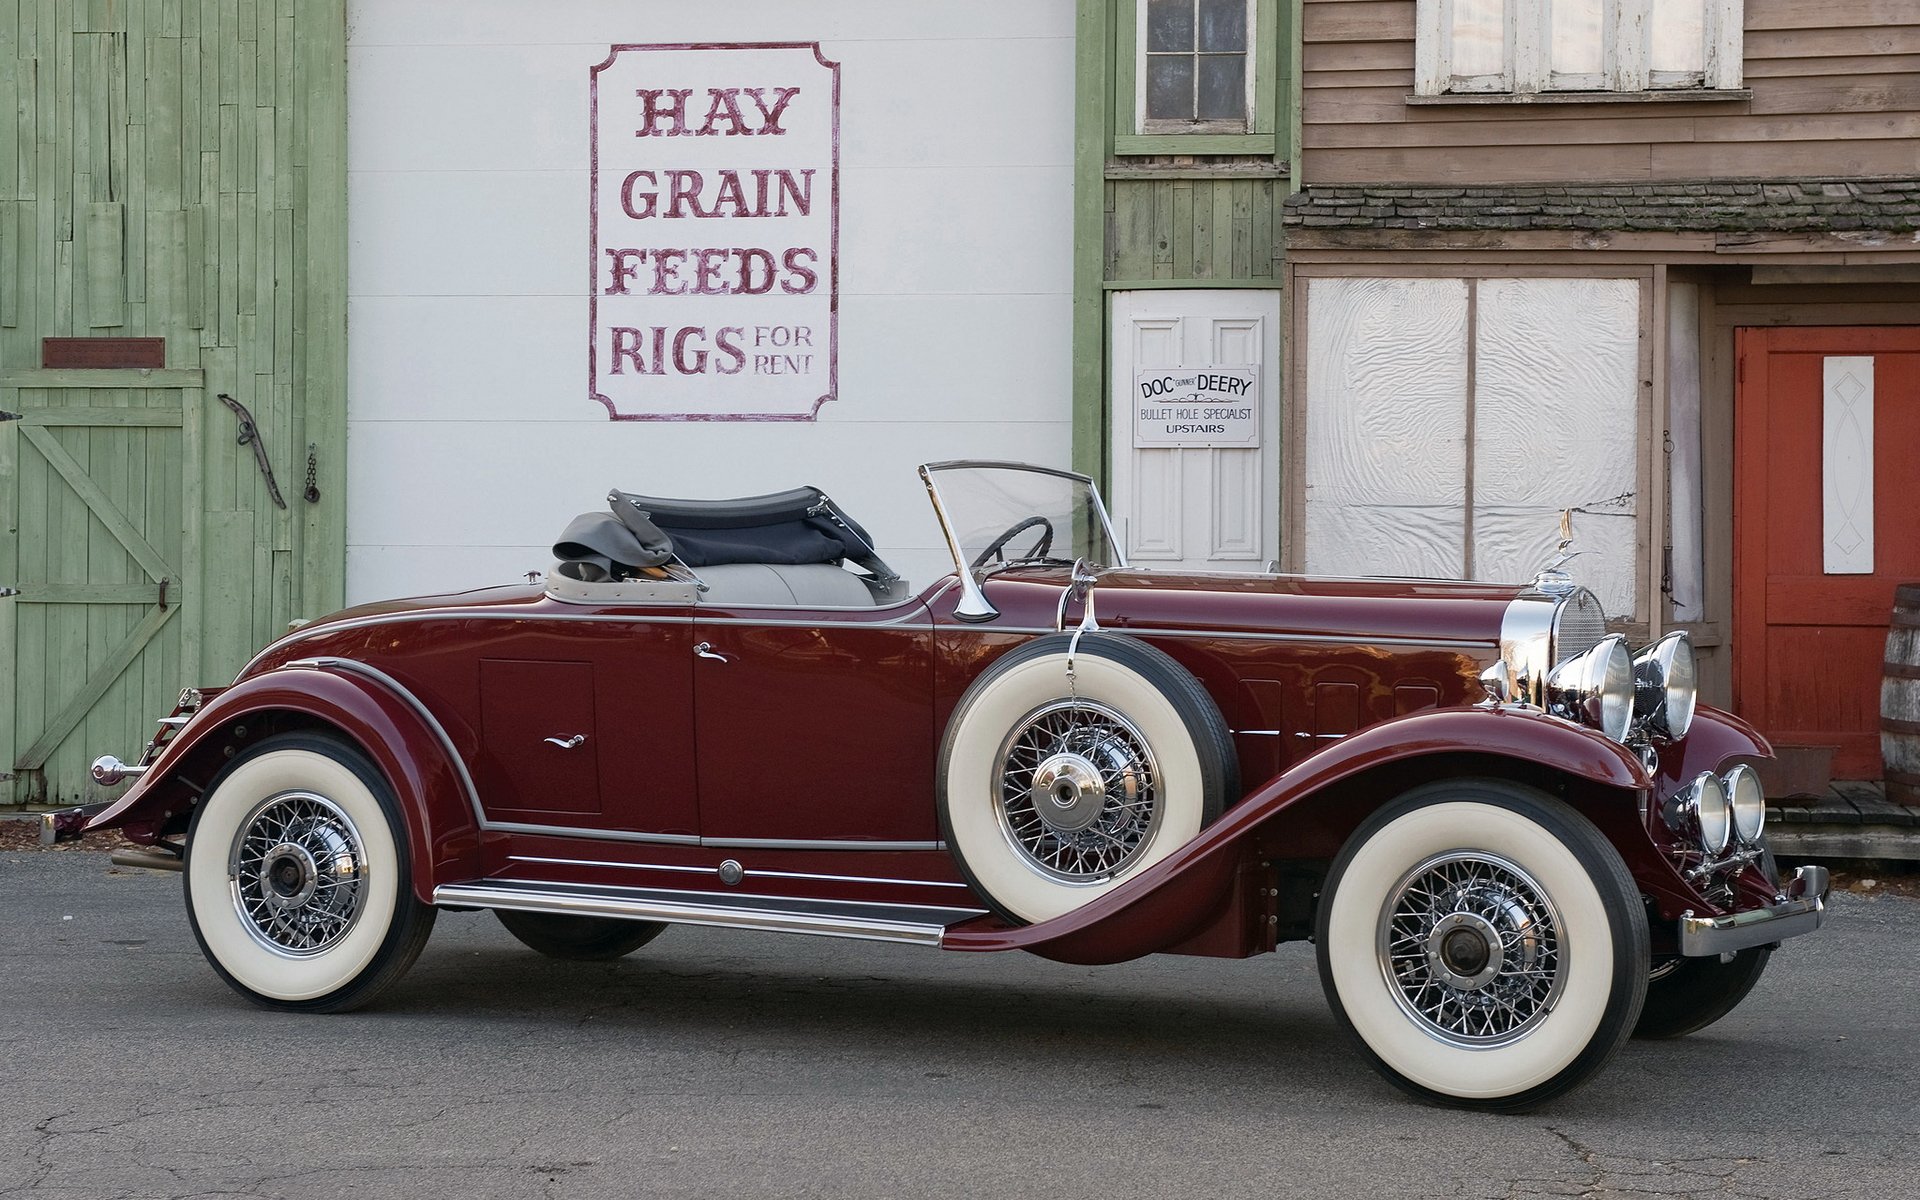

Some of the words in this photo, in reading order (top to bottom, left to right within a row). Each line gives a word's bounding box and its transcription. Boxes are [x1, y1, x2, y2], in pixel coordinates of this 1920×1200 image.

[635, 87, 801, 138] HAY
[620, 169, 816, 220] GRAIN
[605, 247, 819, 295] FEEDS
[753, 326, 813, 347] FOR
[607, 326, 747, 376] RIGS
[753, 354, 813, 376] RENT
[1141, 376, 1174, 398] DOC
[1197, 374, 1253, 396] DEERY
[1140, 408, 1172, 420] BULLET
[1176, 408, 1199, 420] HOLE
[1203, 408, 1252, 420] SPECIALIST
[1166, 424, 1225, 434] UPSTAIRS
